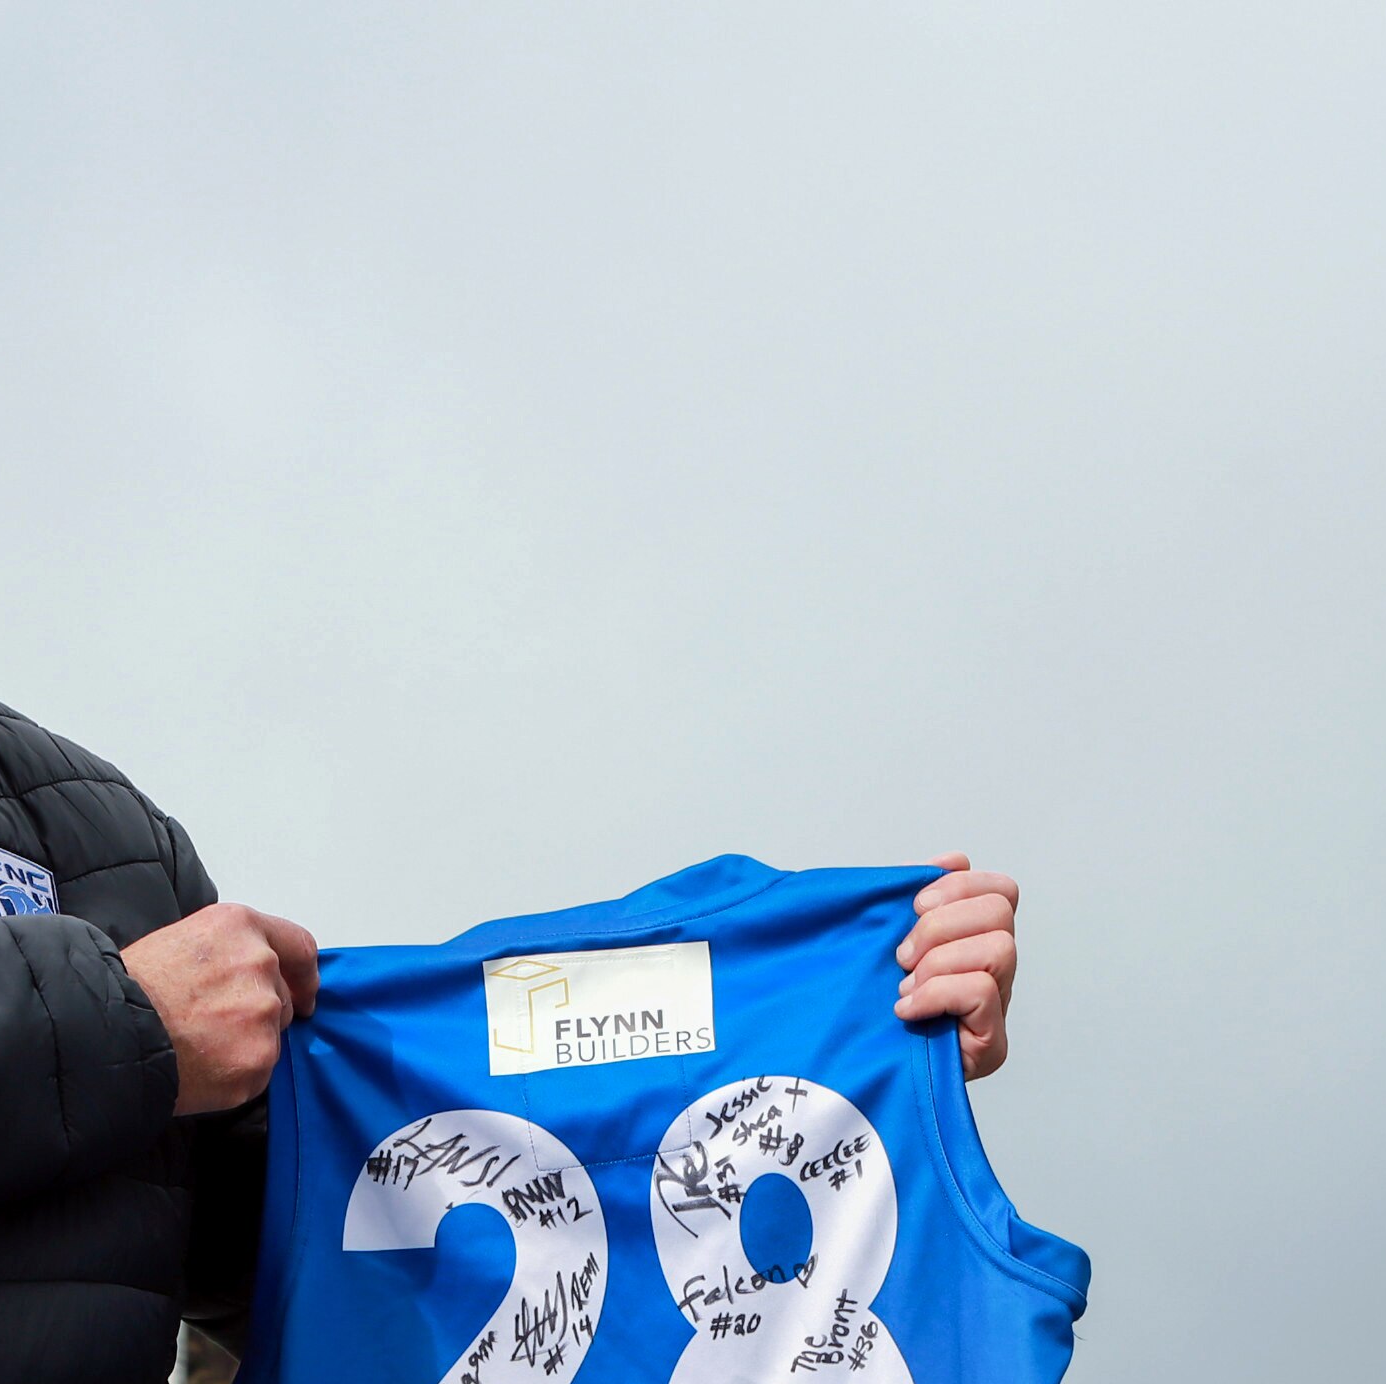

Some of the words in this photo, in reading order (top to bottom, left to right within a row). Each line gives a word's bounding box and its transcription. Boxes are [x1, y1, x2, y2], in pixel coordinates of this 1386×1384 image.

[555, 1009, 663, 1041] FLYNN
[556, 1027, 711, 1065] BUILDERS
[828, 1159, 863, 1192] #1
[538, 1196, 593, 1229] #12
[710, 1311, 761, 1340] #20
[847, 1321, 879, 1372] #36
